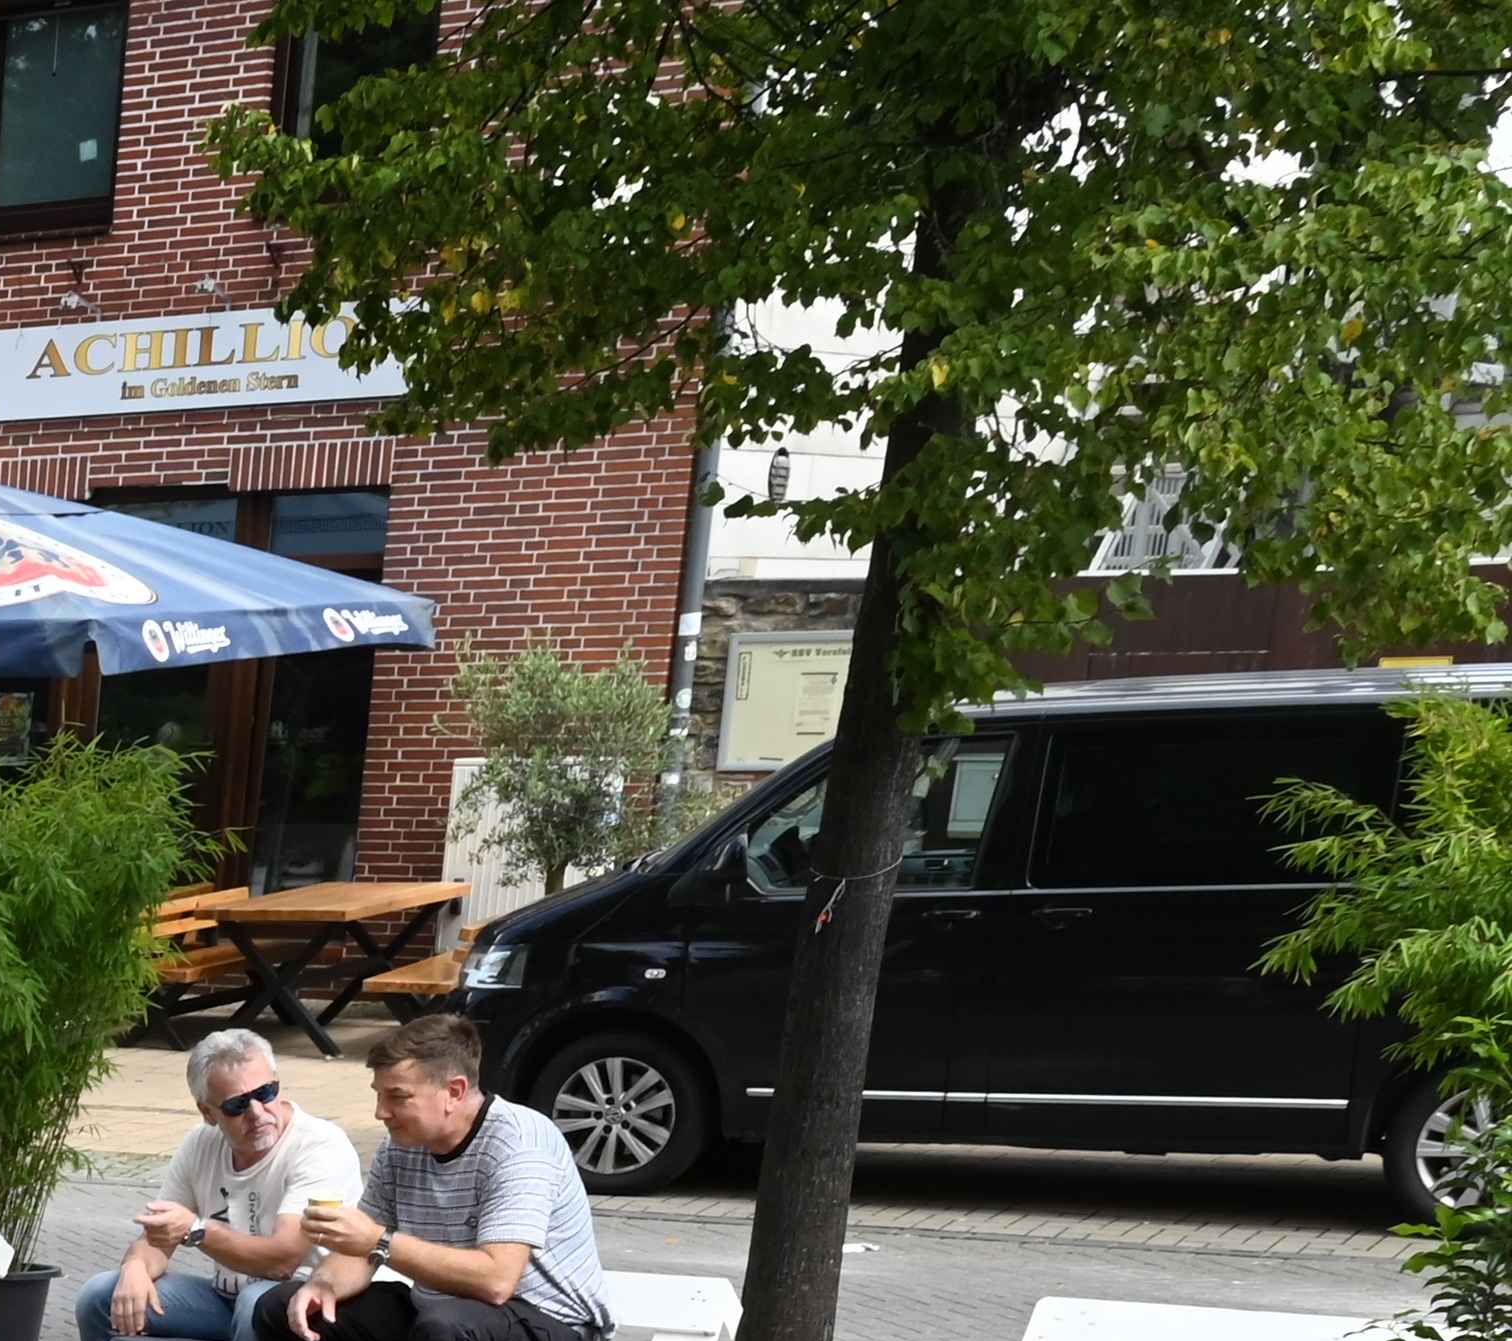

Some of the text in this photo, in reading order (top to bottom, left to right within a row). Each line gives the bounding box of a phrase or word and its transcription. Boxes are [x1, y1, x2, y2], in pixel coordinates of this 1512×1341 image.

[26, 315, 358, 380] ACHILLIO
[120, 371, 300, 400] im Goldenen Stern
